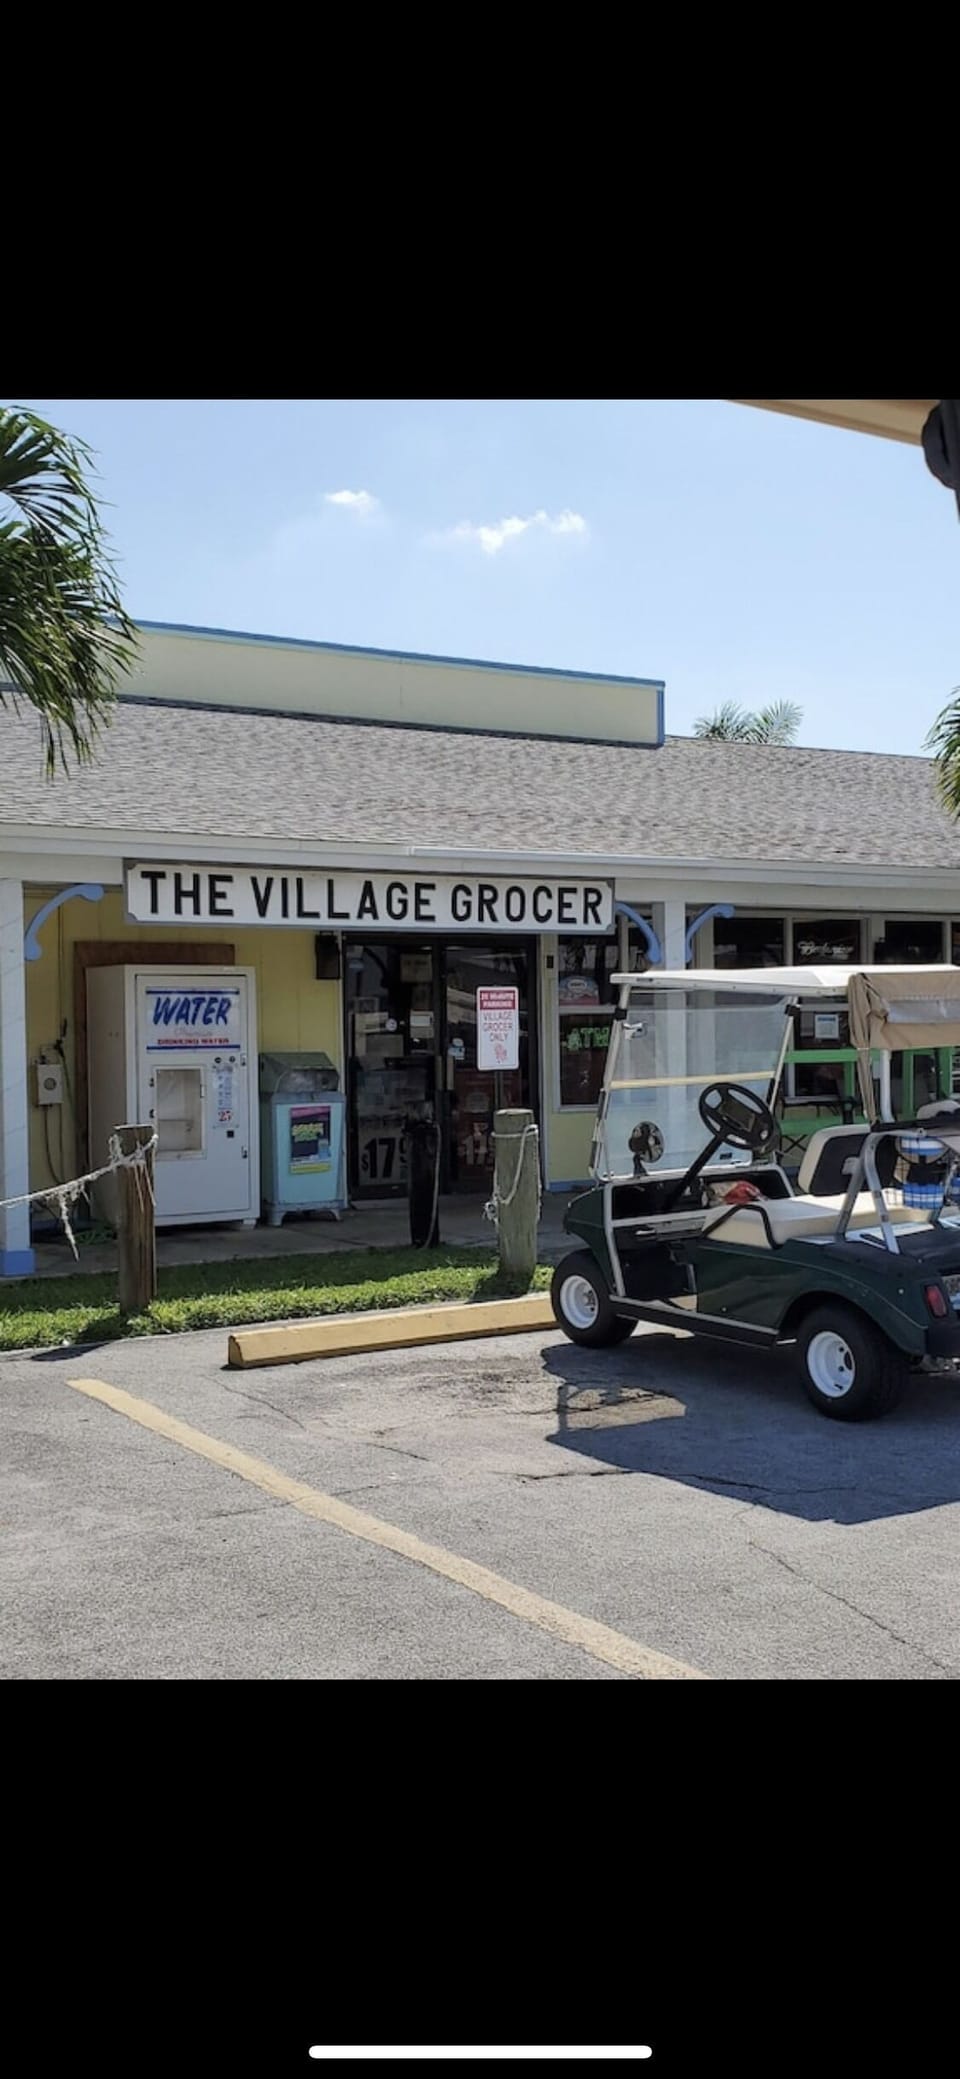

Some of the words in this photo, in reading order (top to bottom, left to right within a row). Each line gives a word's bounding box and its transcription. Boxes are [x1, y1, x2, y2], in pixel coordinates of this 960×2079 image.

[141, 870, 234, 917] THE
[250, 876, 436, 922] VILLAGE
[451, 883, 602, 925] GROCER
[153, 997, 231, 1025] WATER
[483, 1011, 513, 1021] VILLAGE
[483, 1022, 513, 1032] GROCER
[489, 1032, 508, 1042] ONLY
